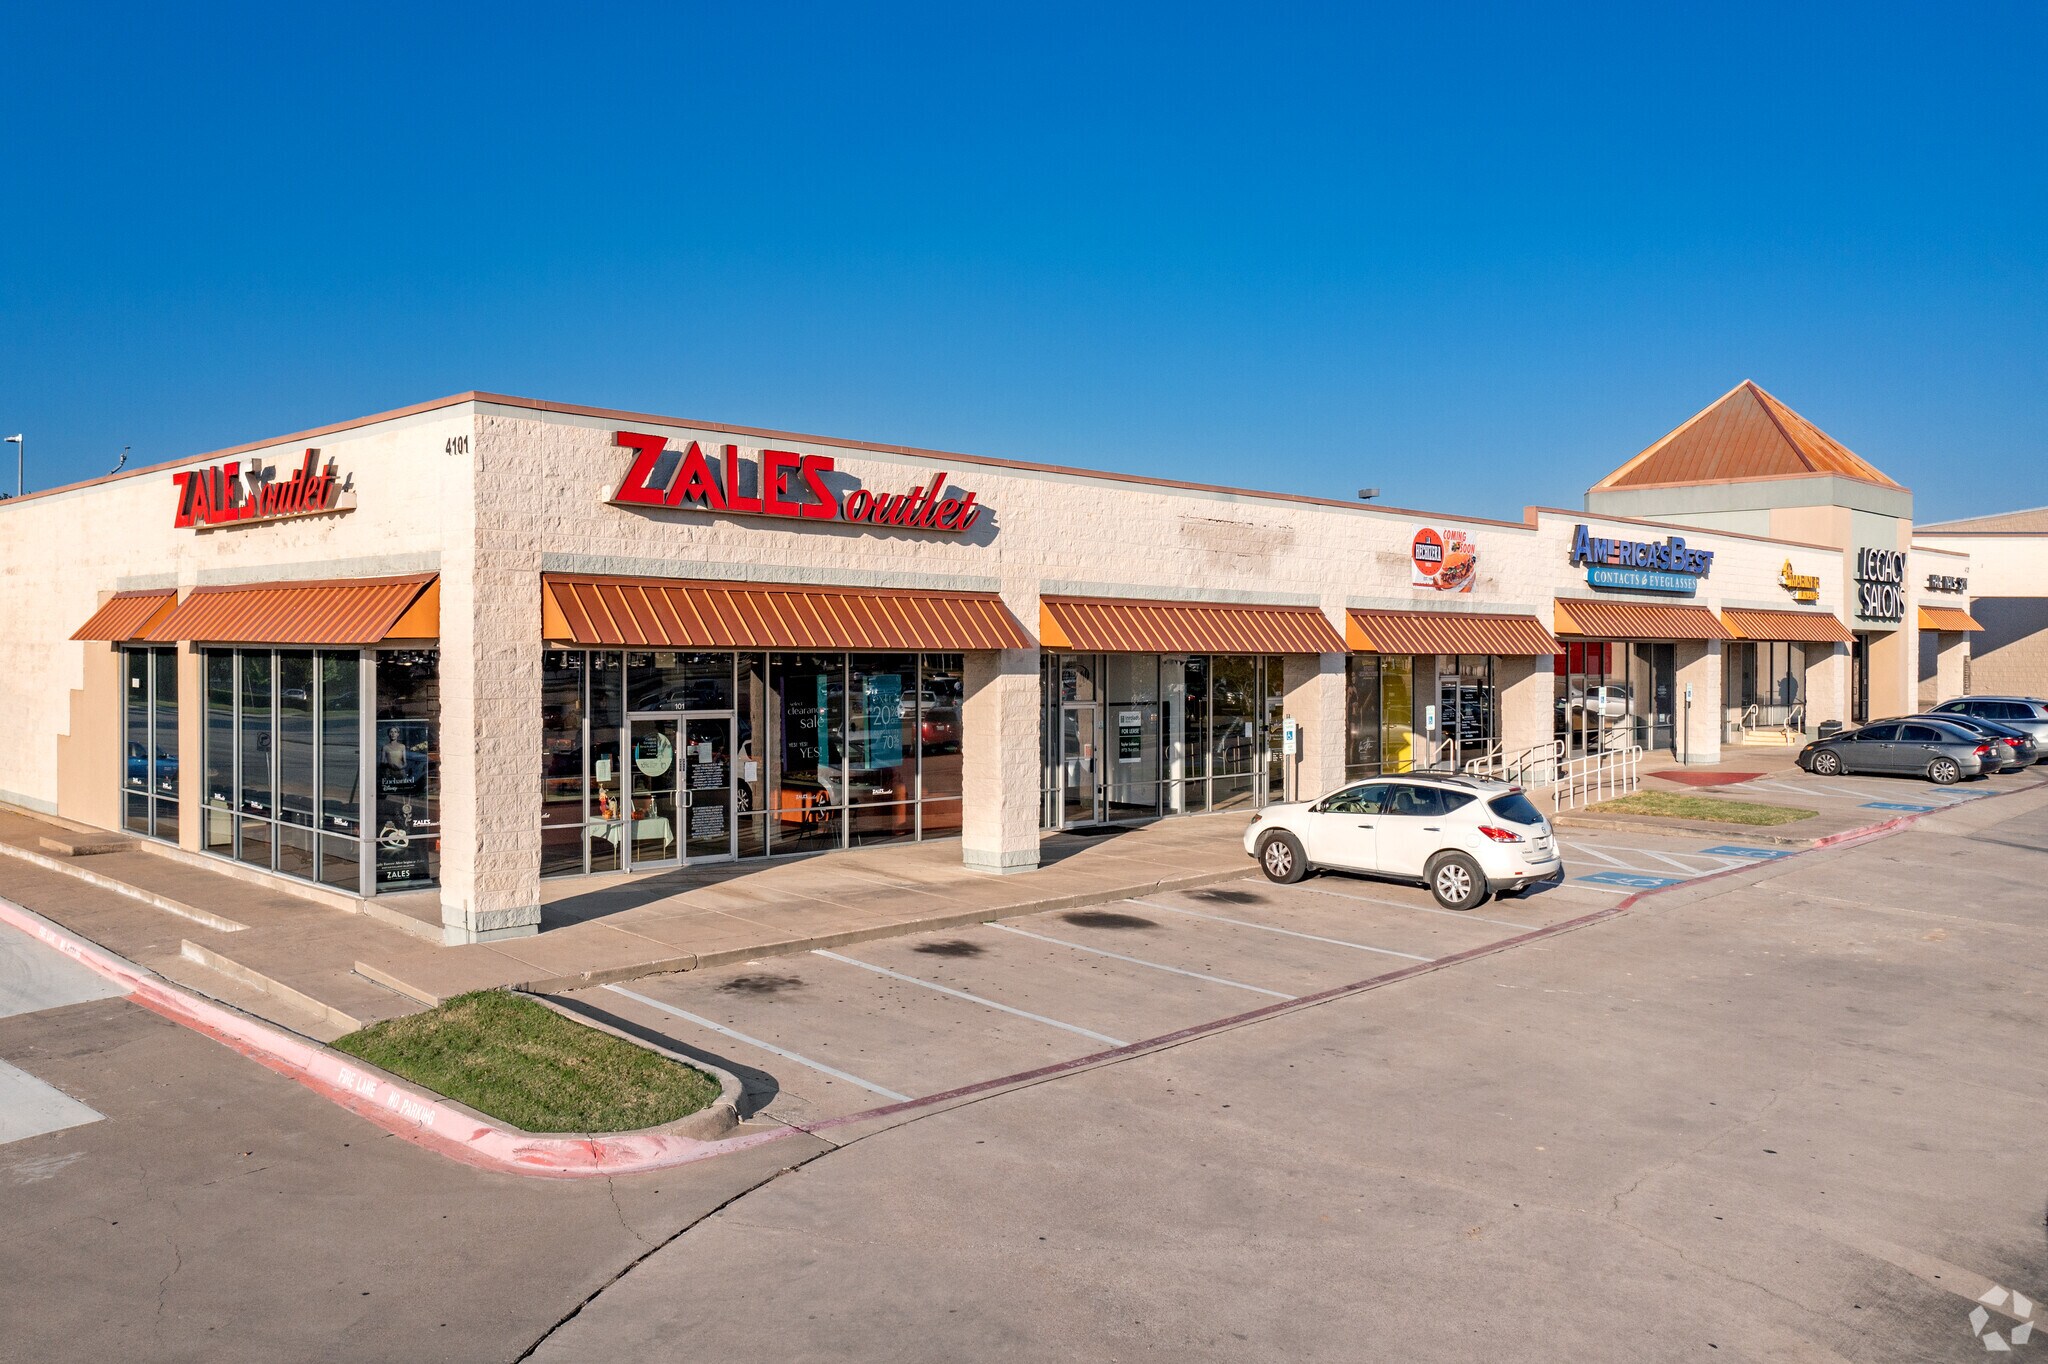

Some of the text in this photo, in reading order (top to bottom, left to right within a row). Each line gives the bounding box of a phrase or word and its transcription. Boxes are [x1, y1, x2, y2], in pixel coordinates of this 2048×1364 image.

[445, 435, 469, 455] 4101
[173, 448, 341, 528] ZALES outlet
[612, 431, 981, 530] ZALES outlet
[1443, 529, 1467, 541] COMING
[1459, 542, 1475, 554] SOON
[1861, 547, 1907, 582] LEGACY
[1593, 571, 1696, 589] CONTACTS & EYEGLASSES
[1863, 583, 1906, 618] SALONS
[800, 714, 825, 729] sale
[387, 870, 410, 878] ZALES
[338, 1068, 377, 1097] FIRE LANE
[387, 1091, 436, 1125] NO PARKING
